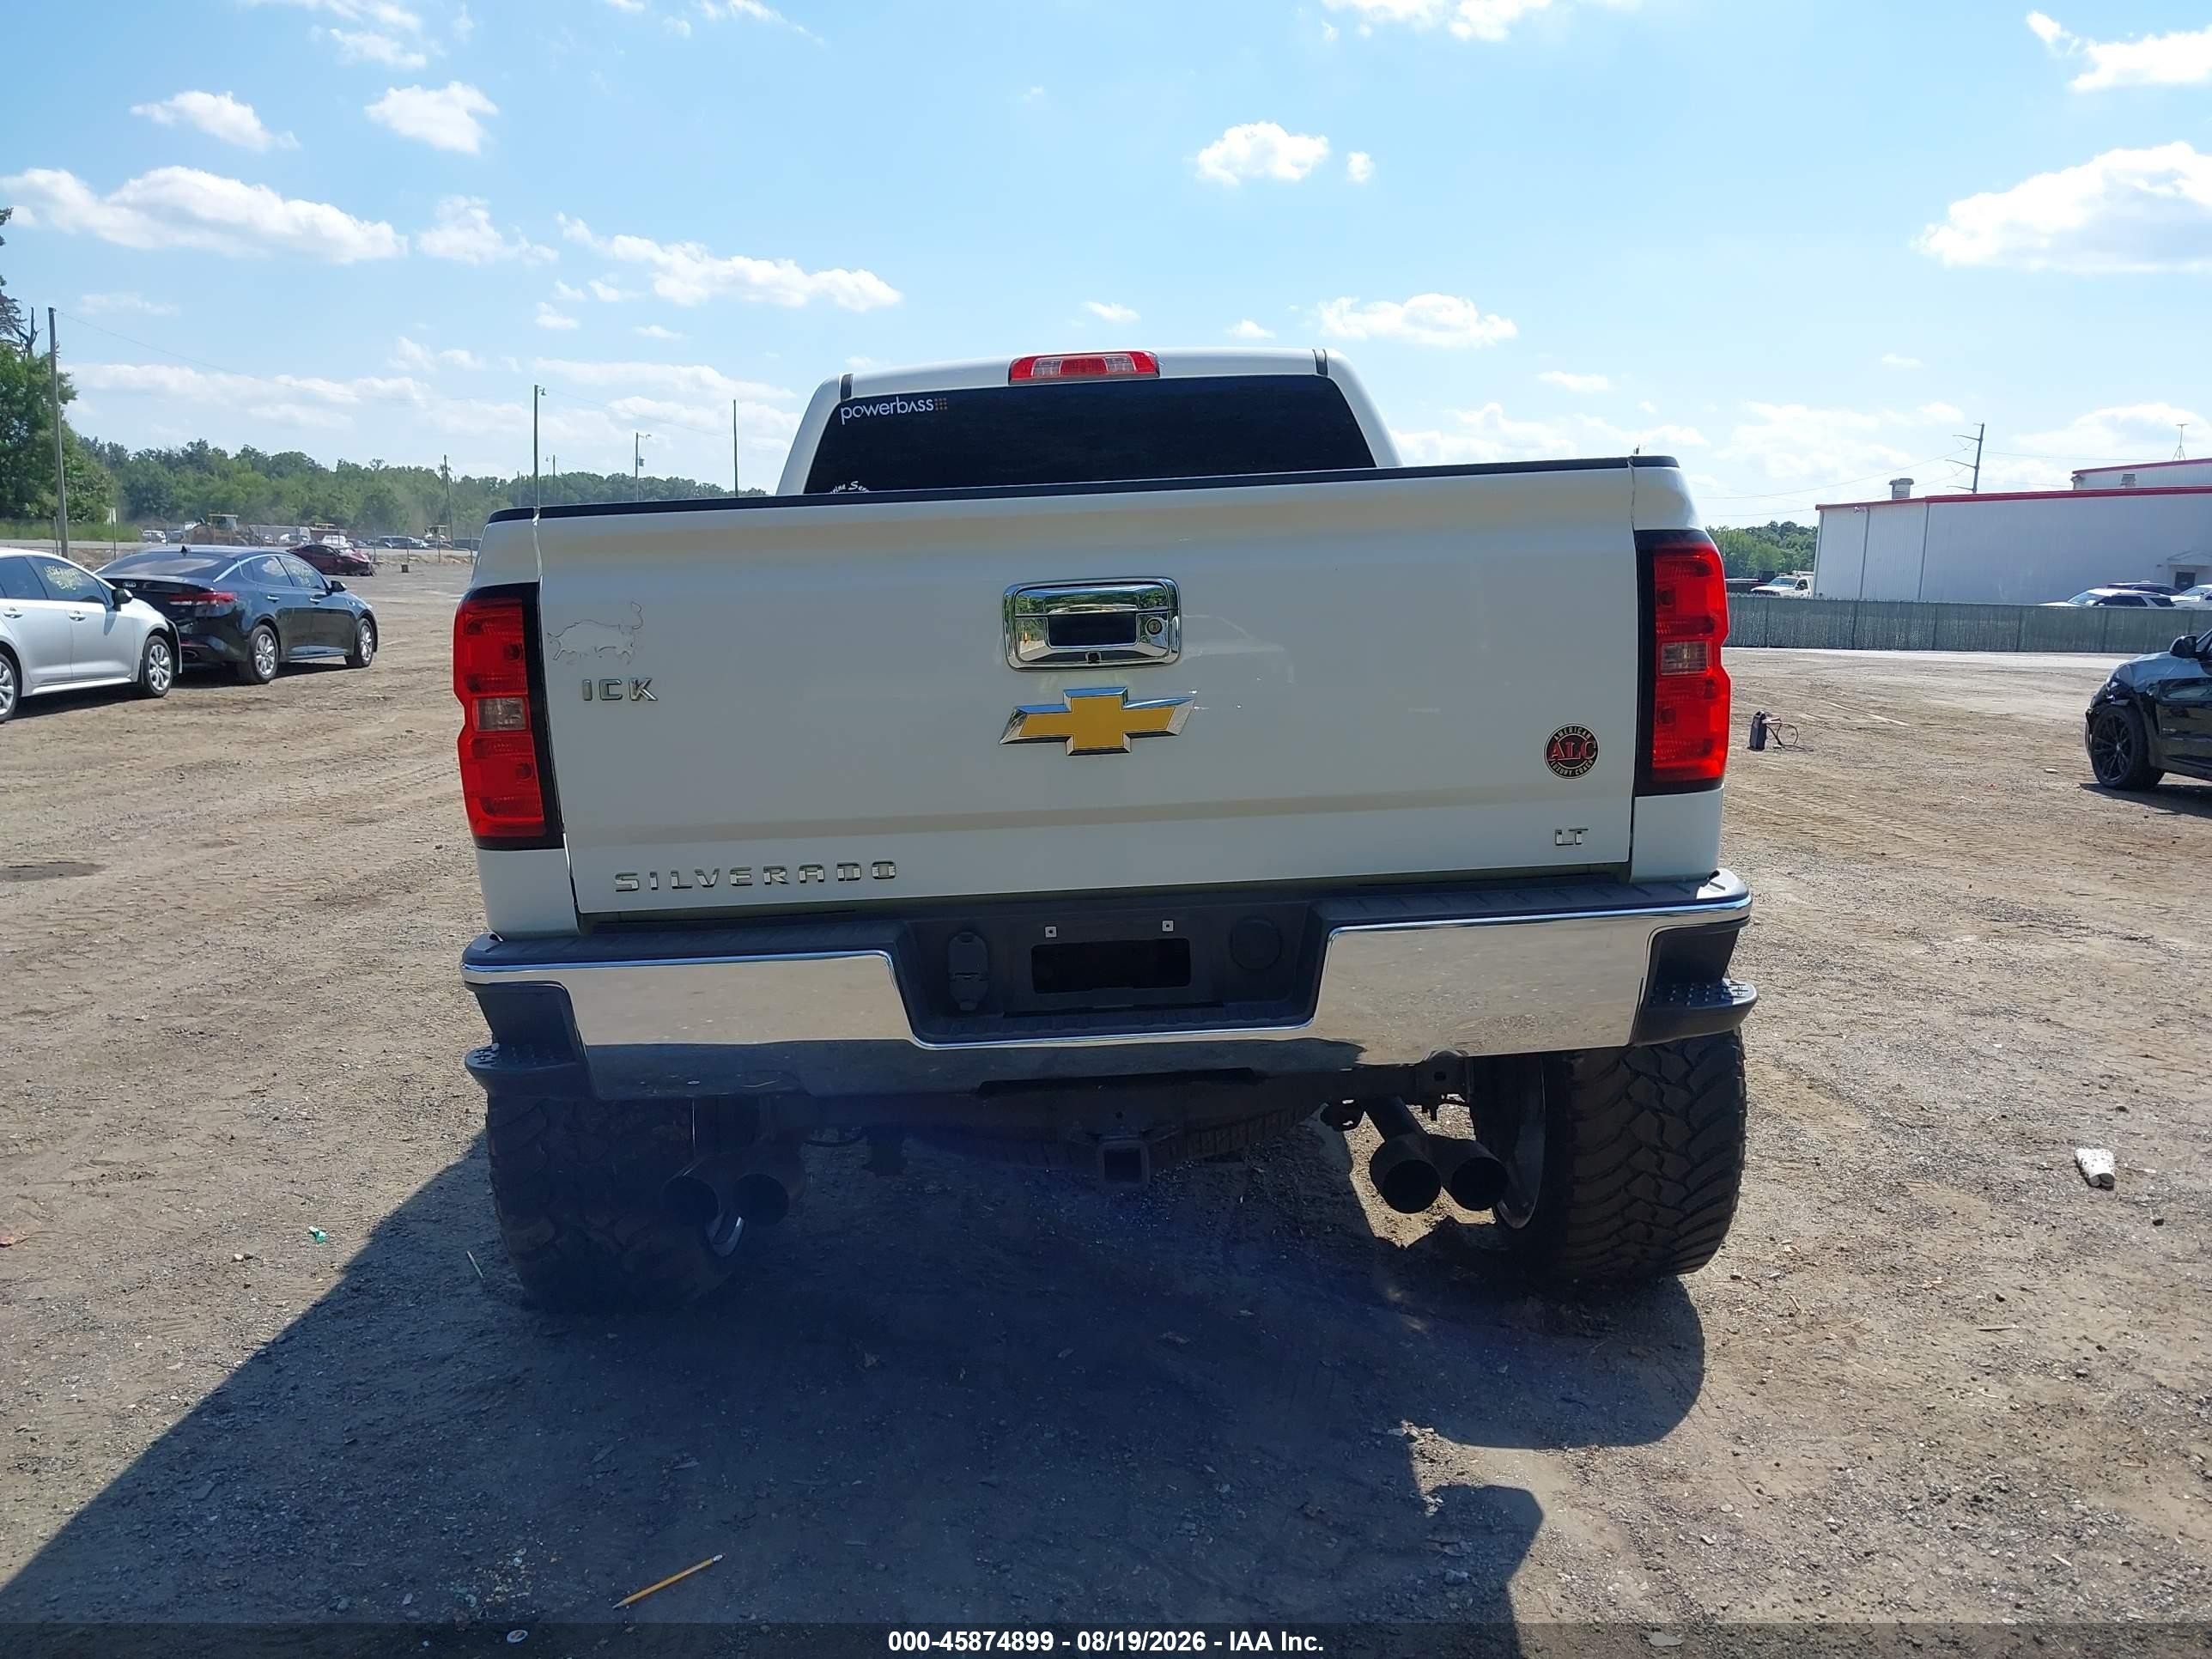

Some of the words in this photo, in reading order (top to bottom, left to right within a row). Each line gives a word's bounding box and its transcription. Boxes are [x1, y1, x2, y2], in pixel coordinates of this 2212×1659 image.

[840, 397, 934, 425] powerbass
[581, 678, 659, 702] ICK
[1554, 726, 1592, 740] AMERICAN
[1548, 740, 1596, 761] ALC
[1550, 761, 1573, 776] LUXURY
[1575, 759, 1595, 775] COACH
[1555, 827, 1589, 846] LT
[614, 860, 896, 892] SILVERADO
